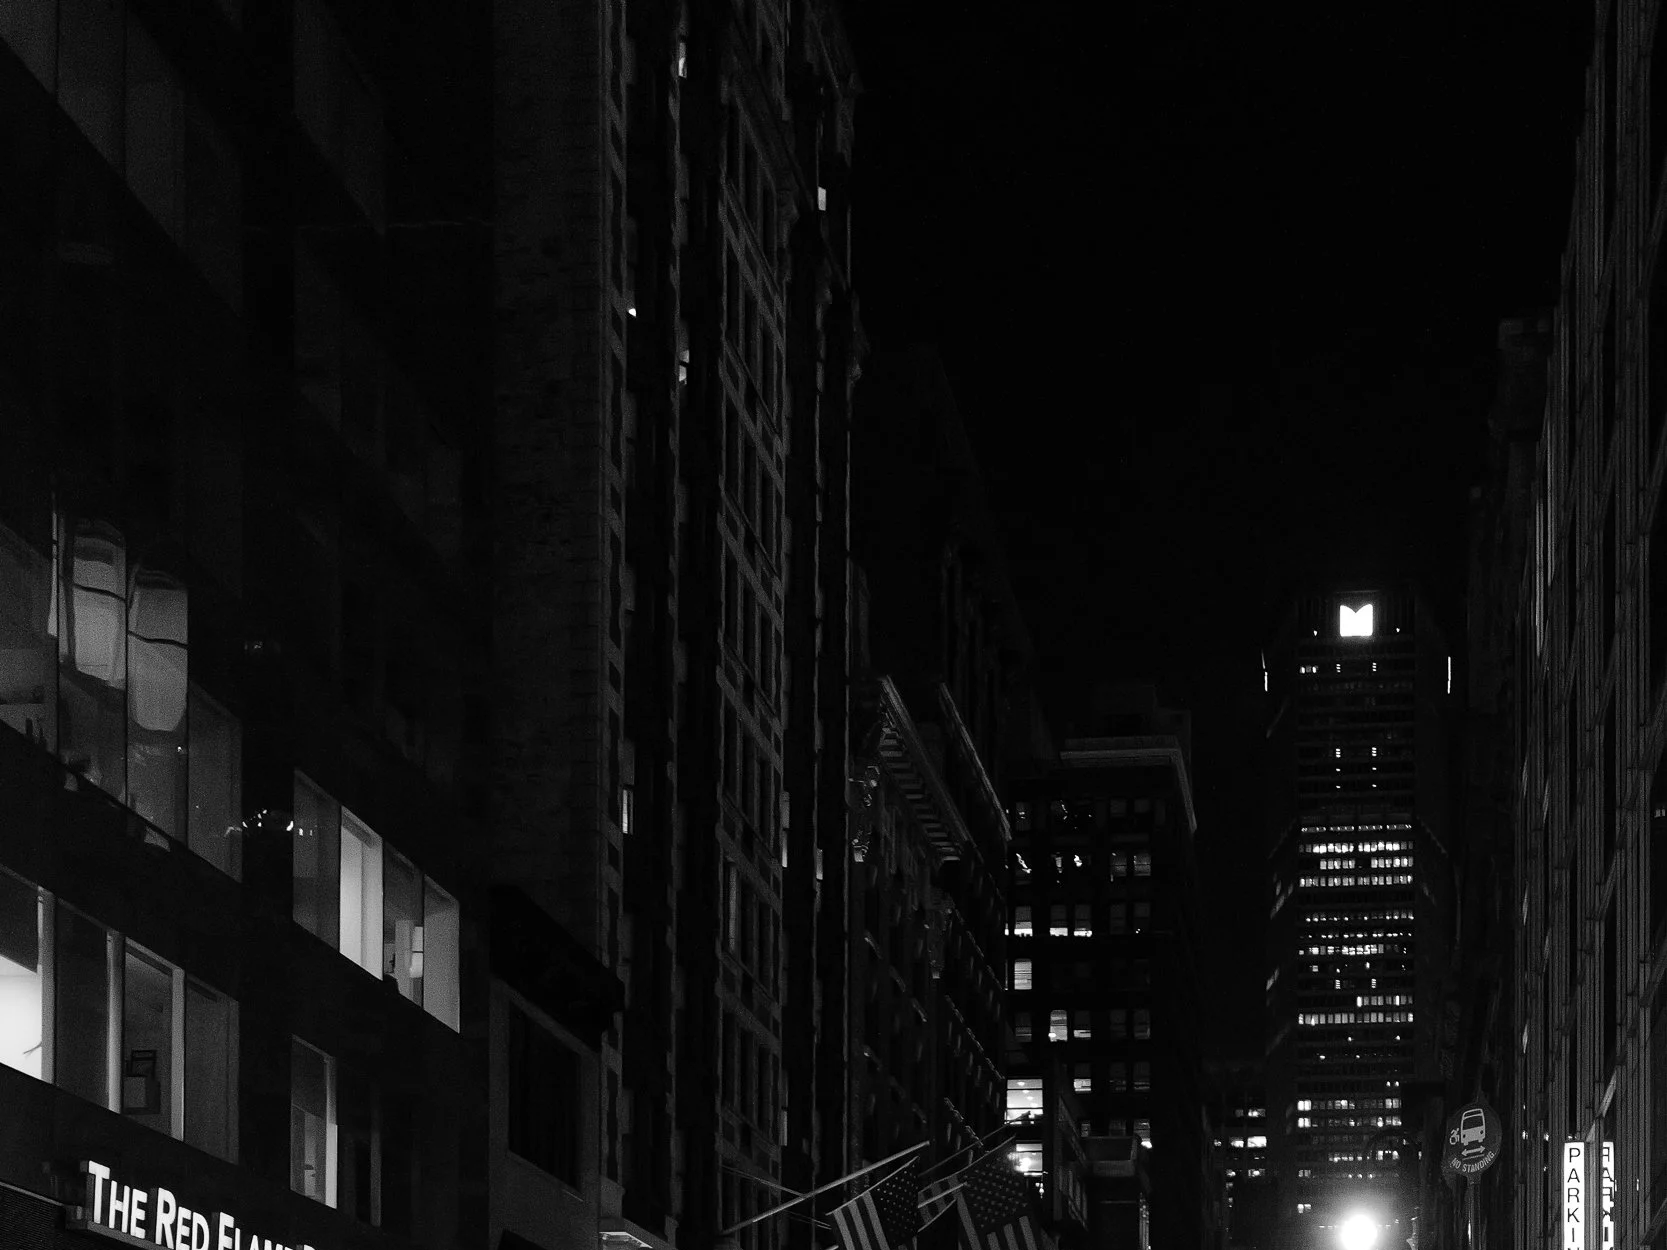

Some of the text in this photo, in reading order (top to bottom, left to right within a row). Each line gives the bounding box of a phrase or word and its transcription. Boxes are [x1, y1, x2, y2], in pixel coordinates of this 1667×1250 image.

[1451, 1151, 1495, 1173] NO STANDING
[88, 1160, 148, 1239] THE
